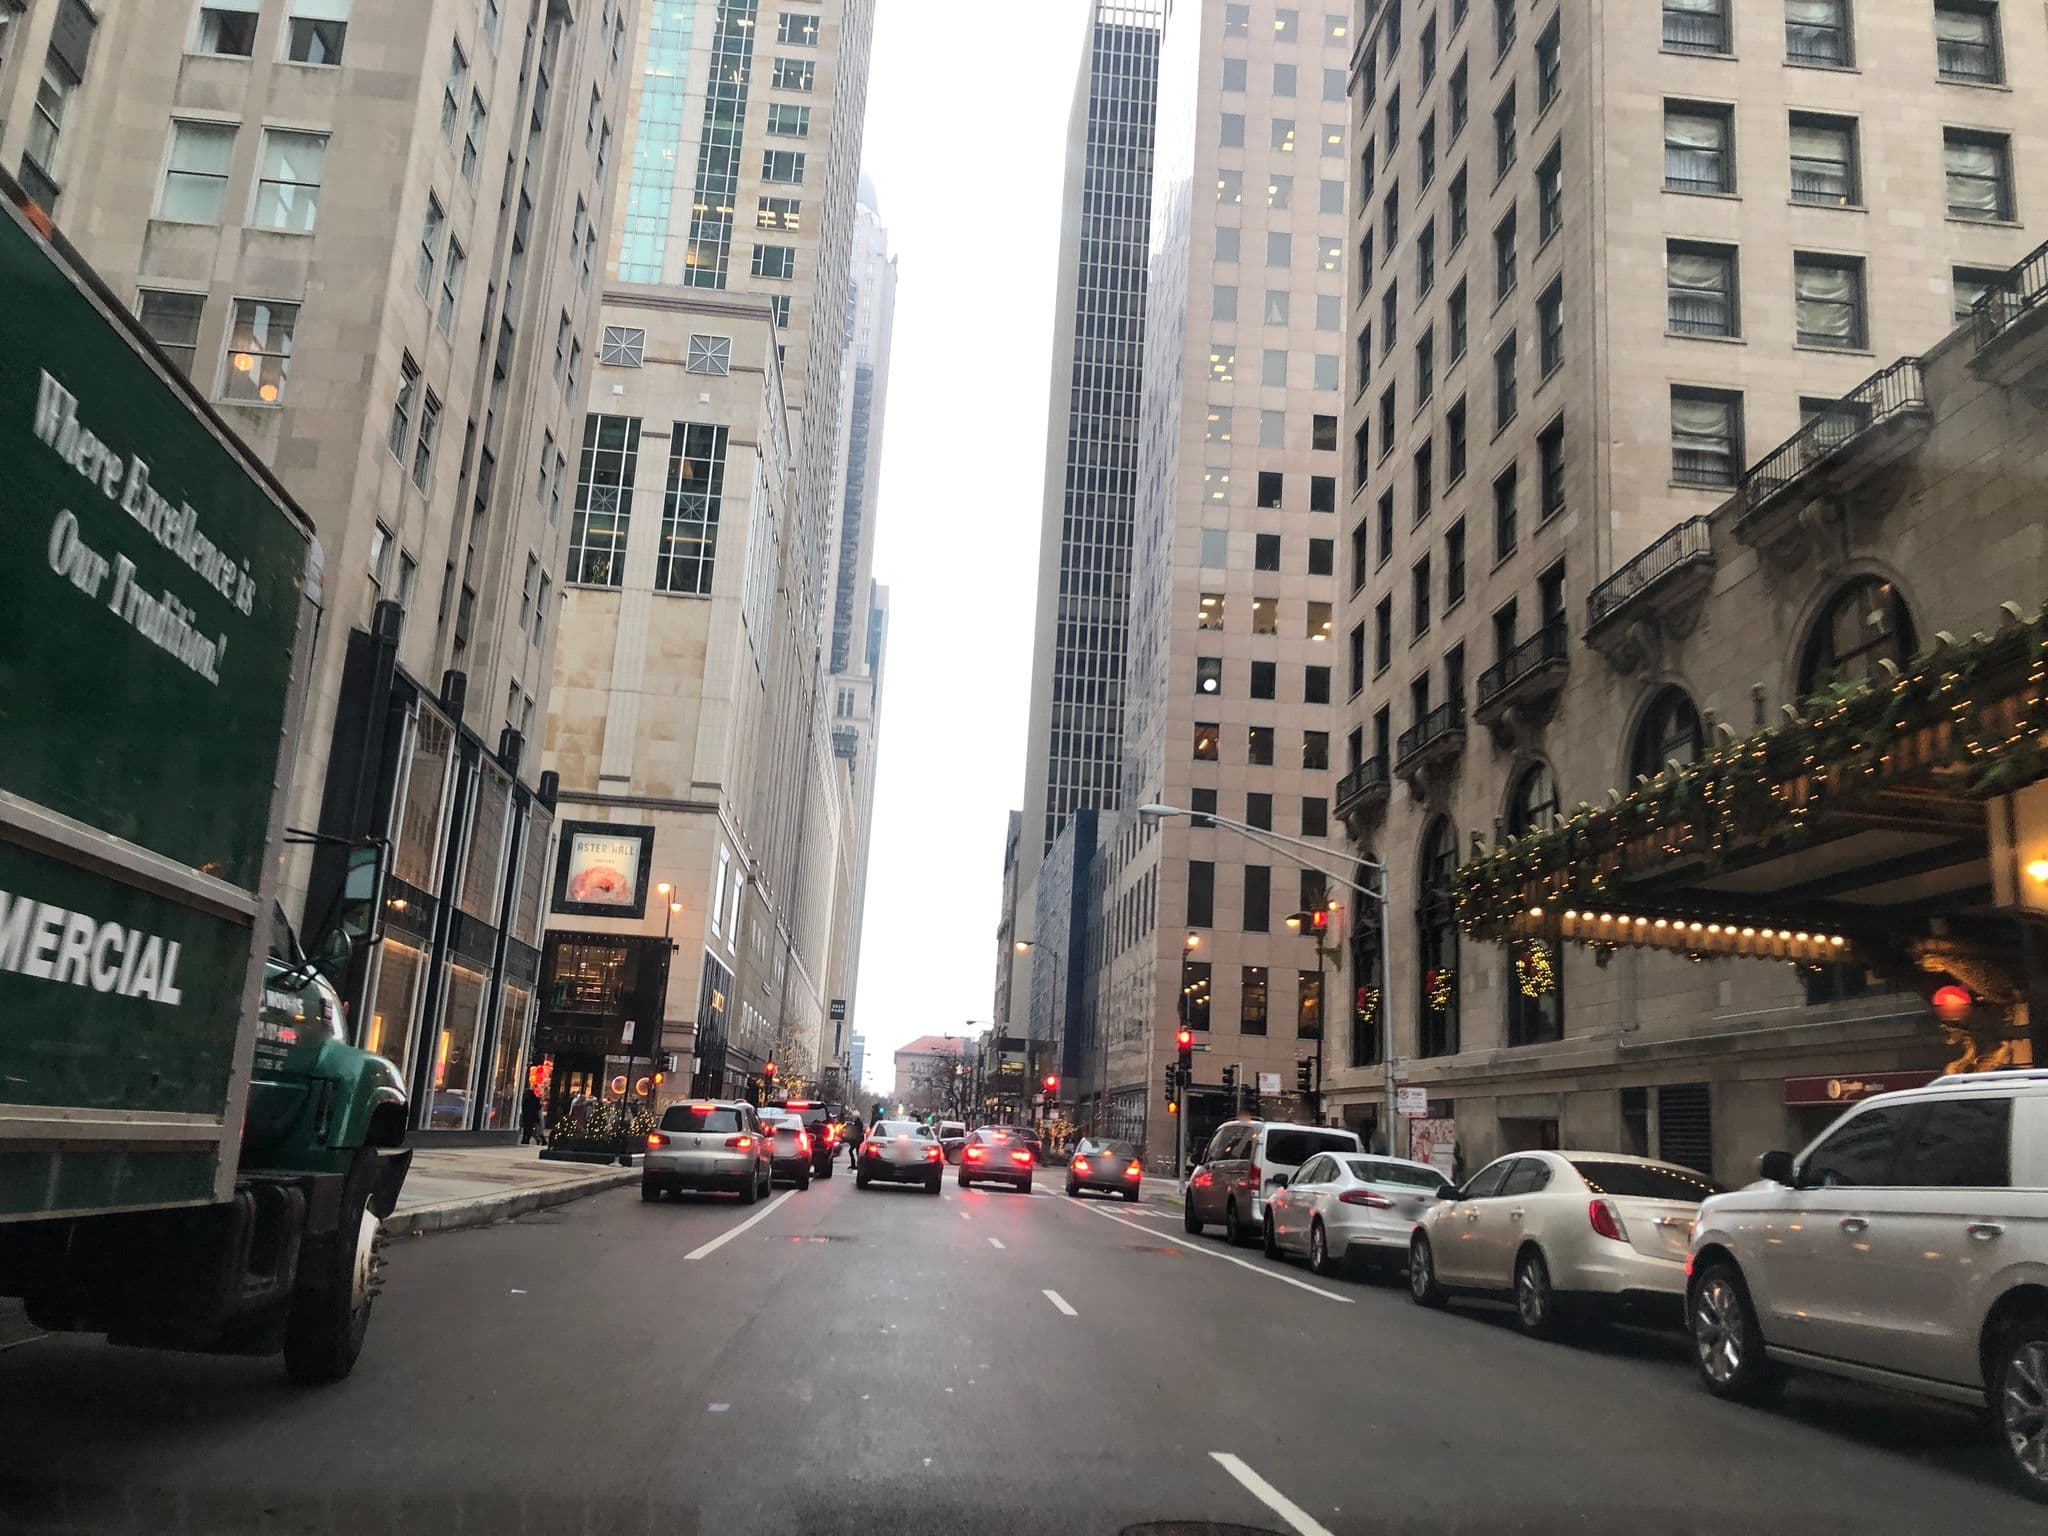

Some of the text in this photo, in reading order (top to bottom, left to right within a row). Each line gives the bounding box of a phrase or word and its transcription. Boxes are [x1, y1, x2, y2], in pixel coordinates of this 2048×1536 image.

[33, 367, 256, 617] Where Excellence is
[48, 508, 228, 687] Our Tradition!
[577, 842, 635, 856] ASTER HALL
